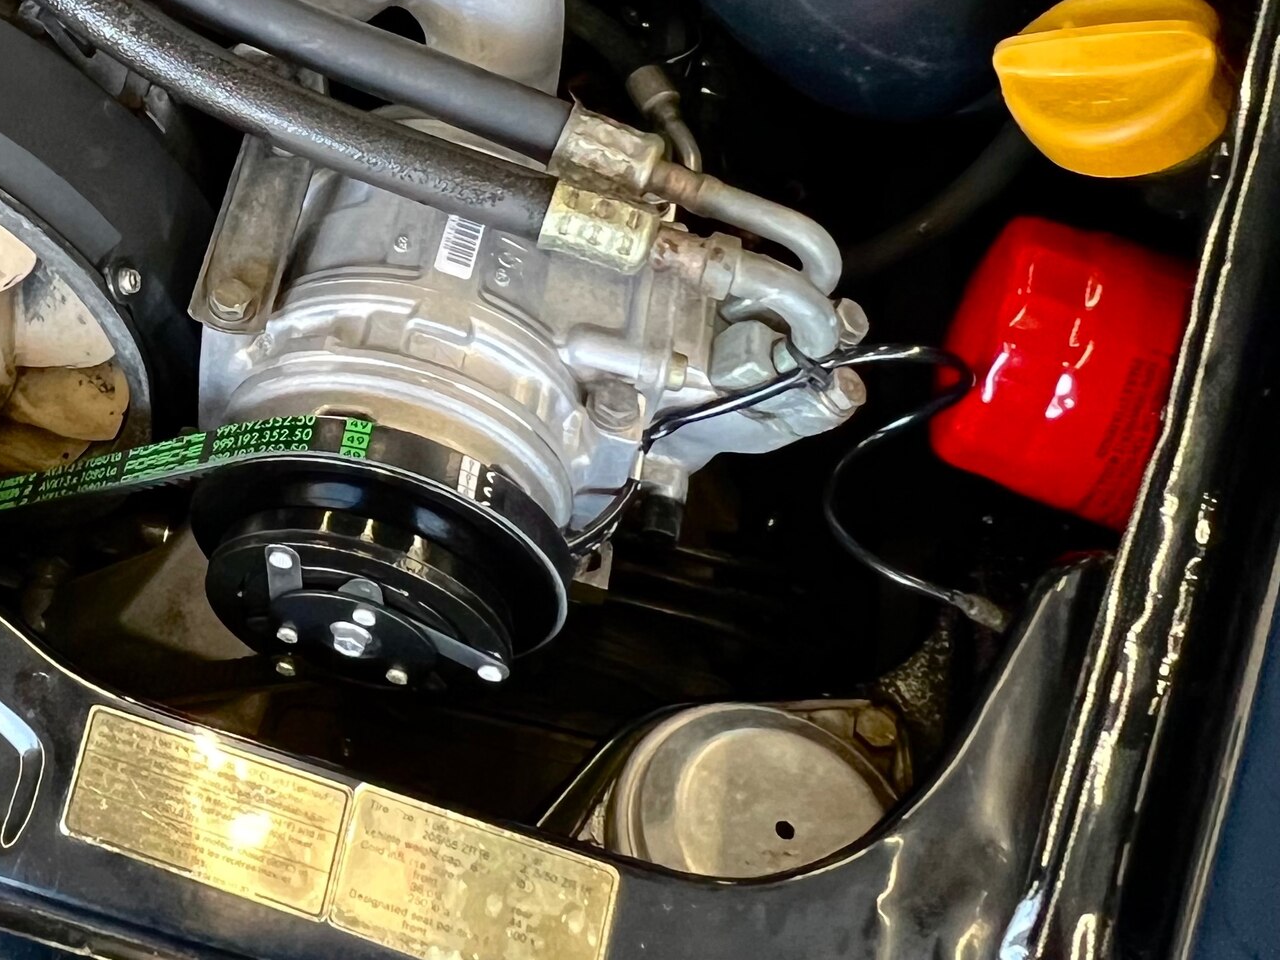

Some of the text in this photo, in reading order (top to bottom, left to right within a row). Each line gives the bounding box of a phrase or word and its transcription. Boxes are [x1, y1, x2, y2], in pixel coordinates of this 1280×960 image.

[212, 428, 313, 452] 999.192.352.50
[346, 435, 365, 445] 49
[349, 887, 409, 917] Designated
